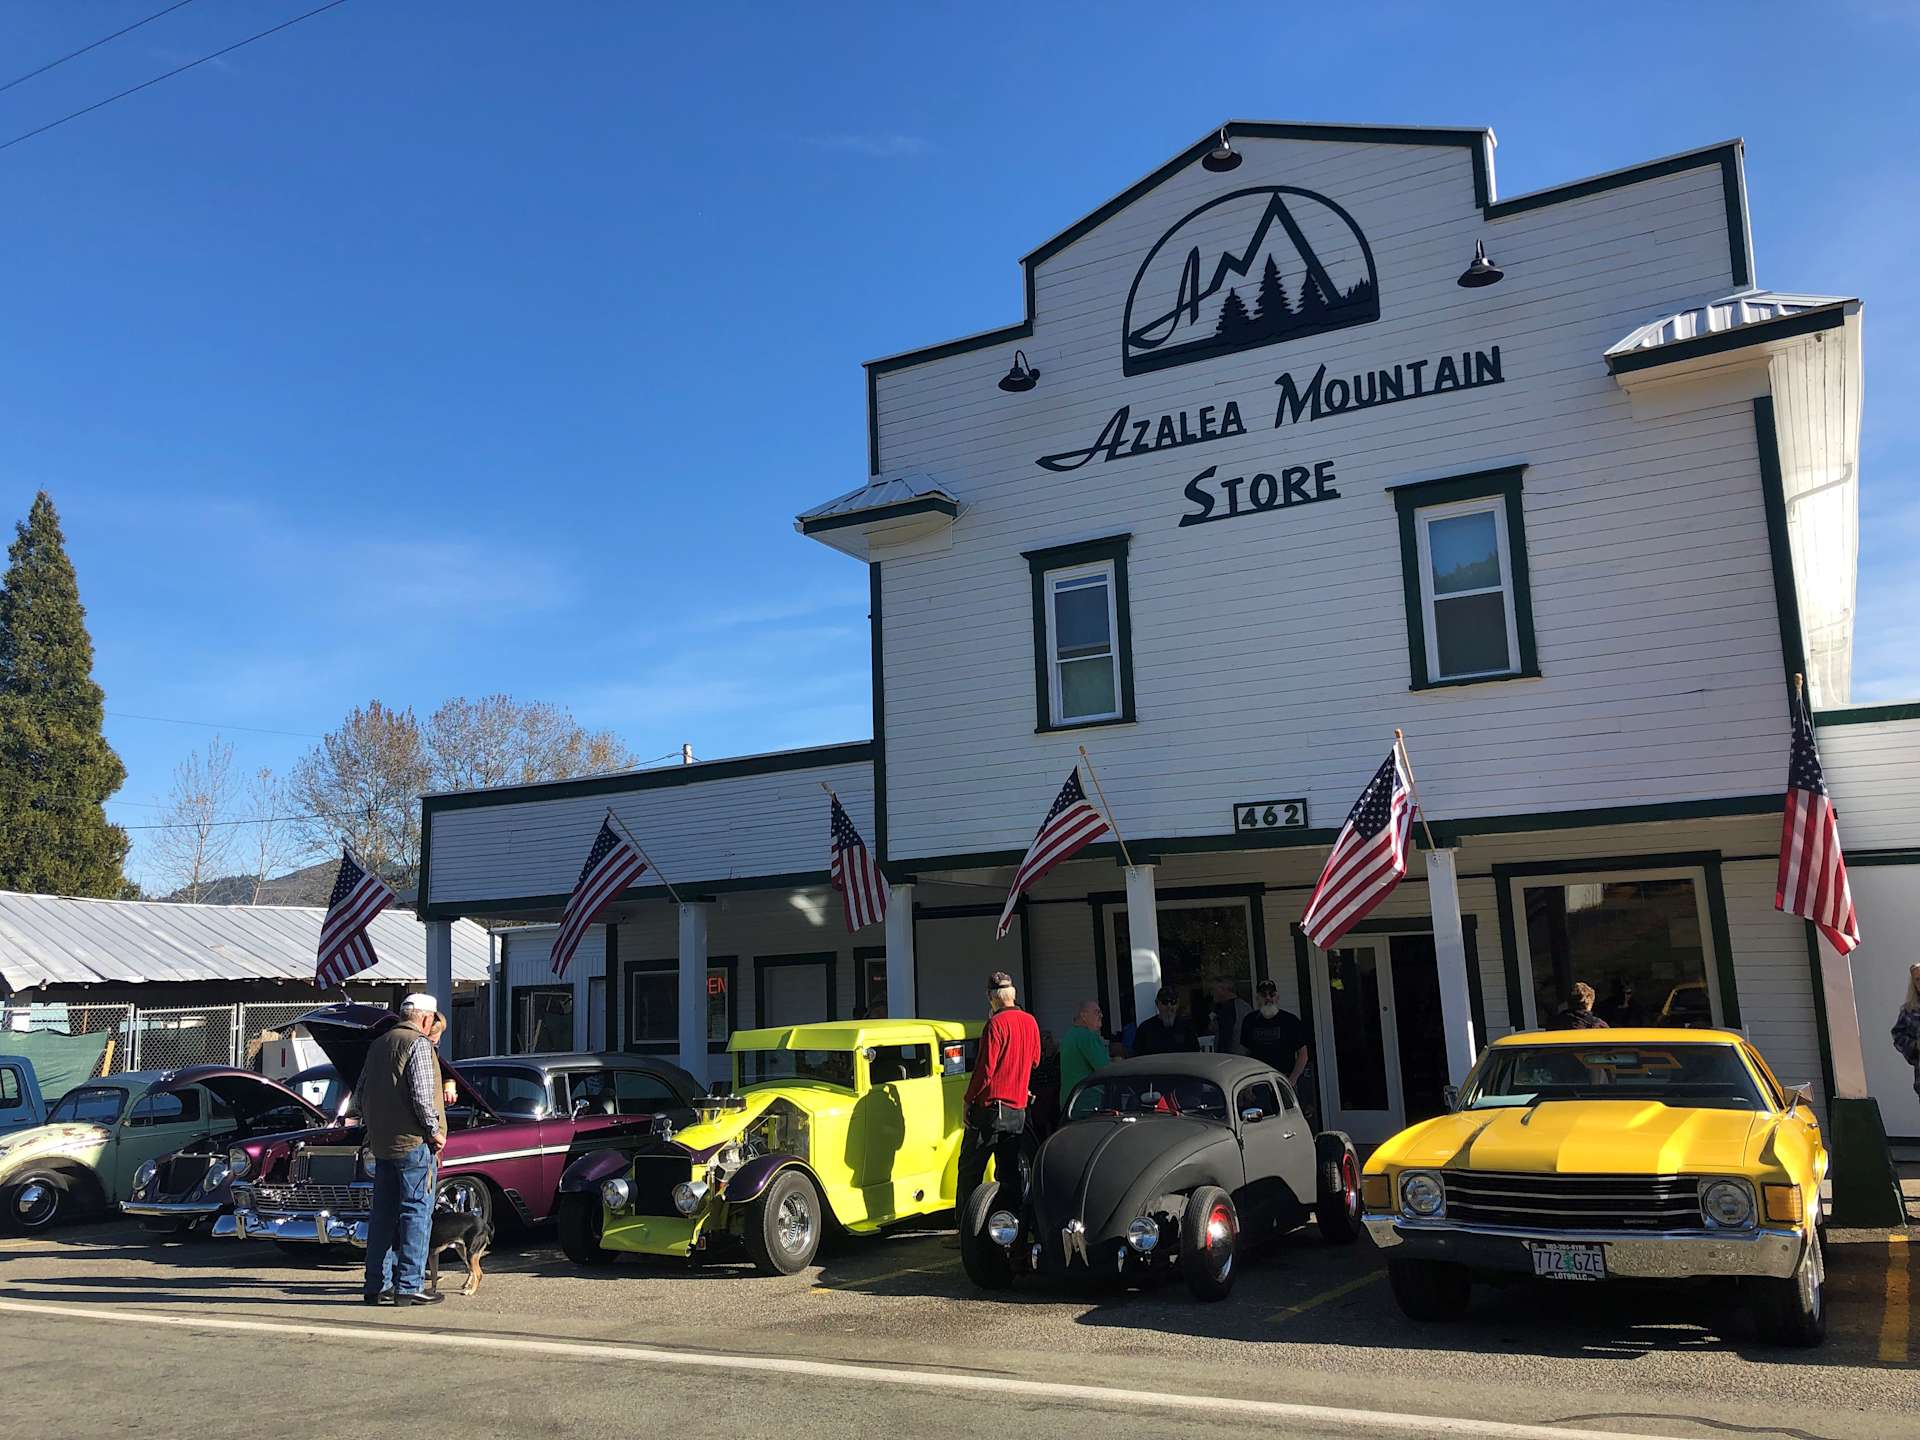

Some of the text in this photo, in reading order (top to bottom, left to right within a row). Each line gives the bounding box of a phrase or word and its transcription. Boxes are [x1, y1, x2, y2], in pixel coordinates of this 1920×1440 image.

[1035, 345, 1505, 472] AZALEA MOUNTAIN
[1178, 460, 1341, 527] STORE
[1241, 804, 1300, 827] 462
[707, 976, 726, 994] EN
[1533, 1250, 1603, 1273] 772 GZE
